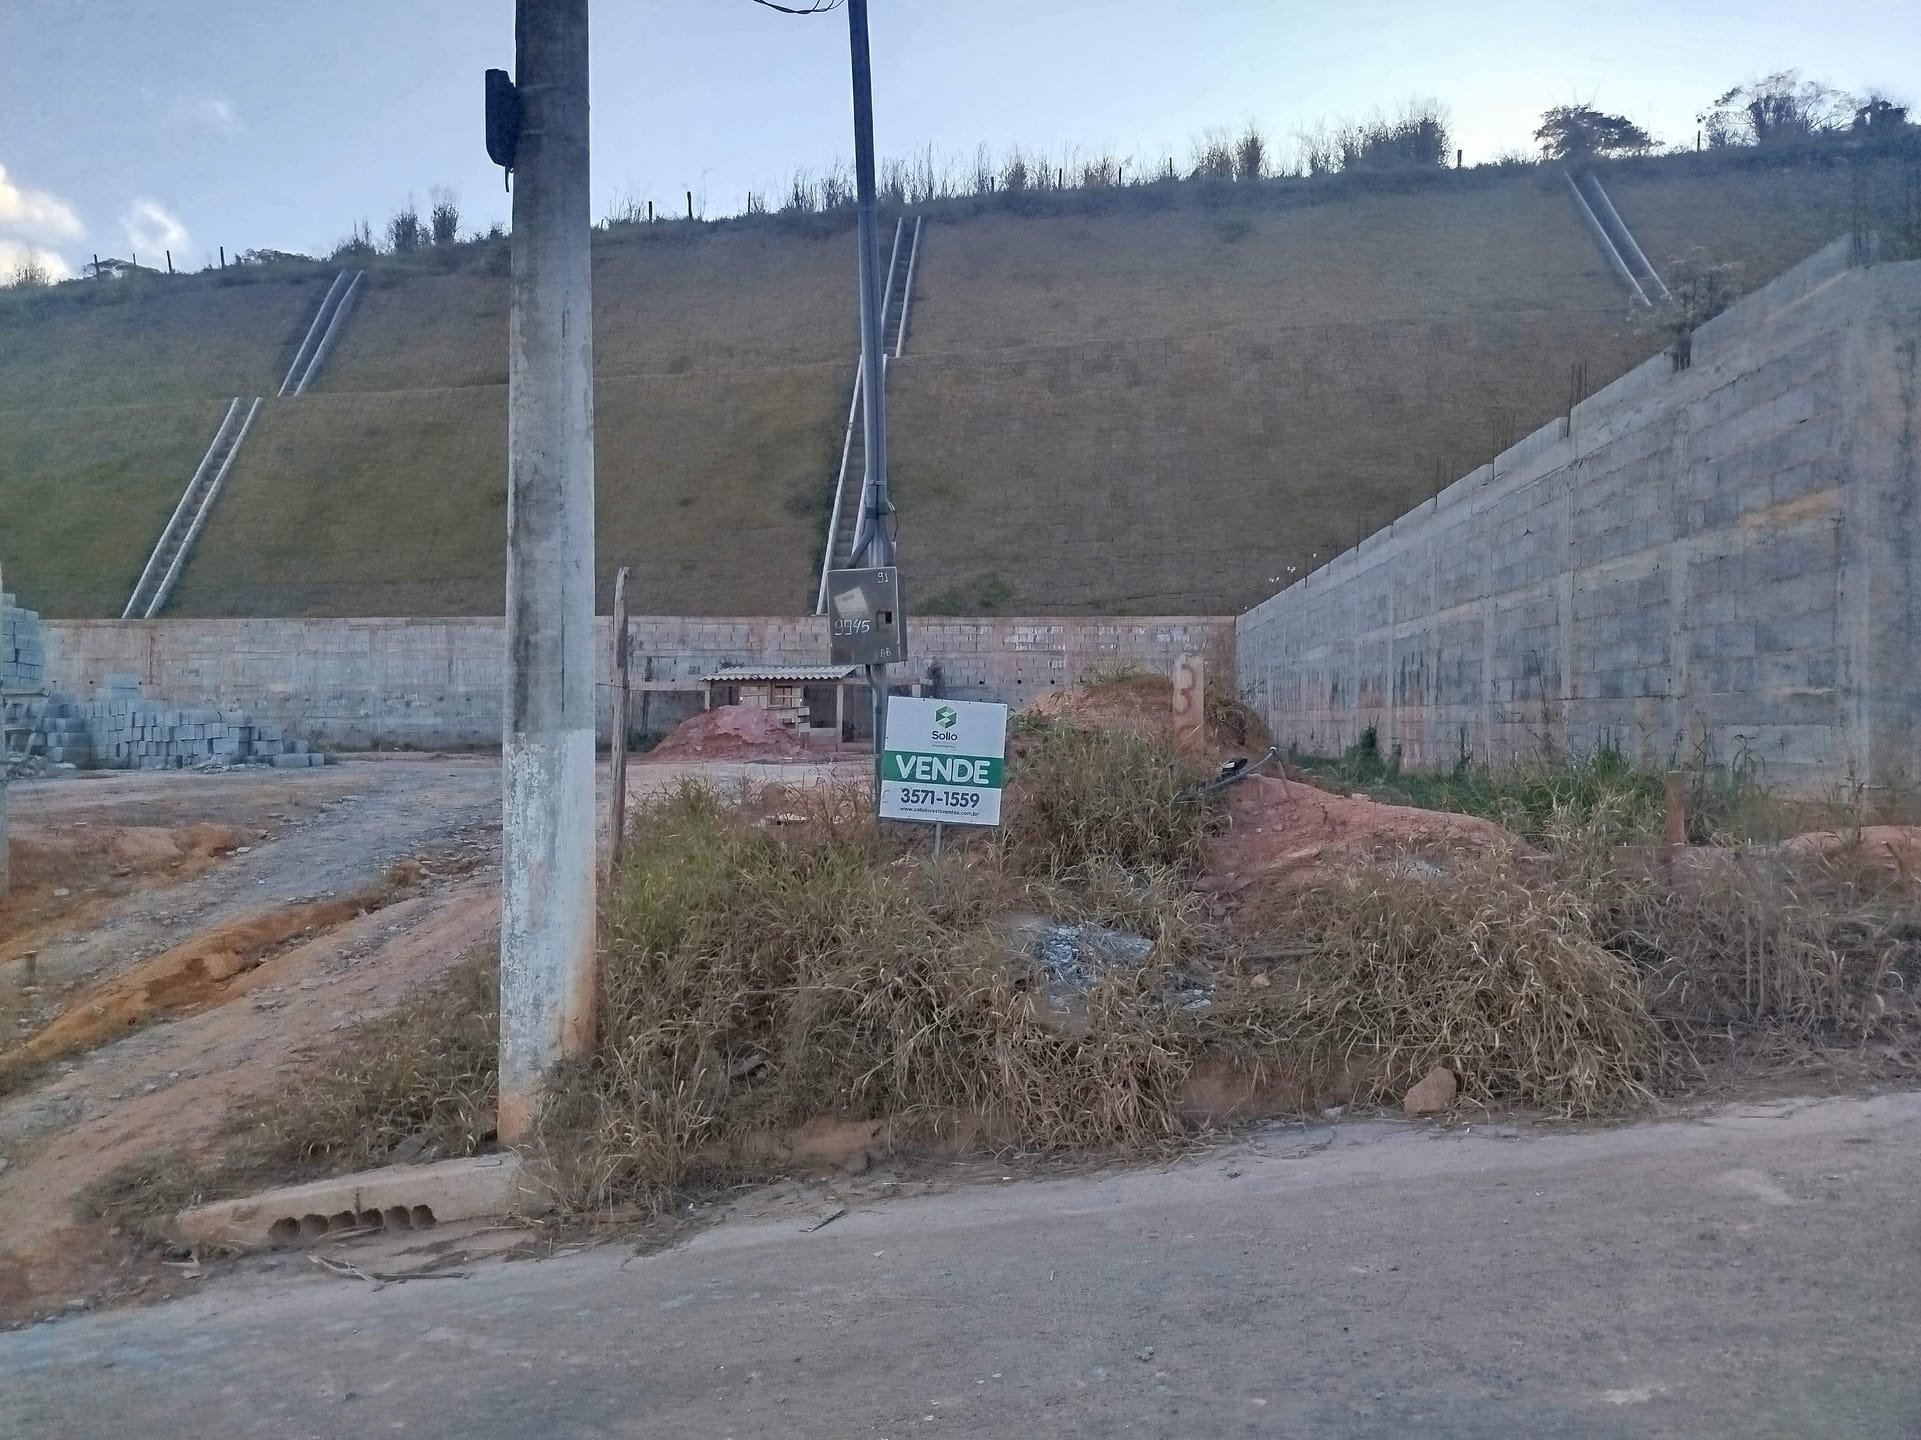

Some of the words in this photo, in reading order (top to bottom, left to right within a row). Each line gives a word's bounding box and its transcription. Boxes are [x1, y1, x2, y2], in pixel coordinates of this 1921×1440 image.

[932, 730, 958, 741] Sollo
[896, 754, 990, 785] VENDE
[900, 788, 980, 808] 3571-1559
